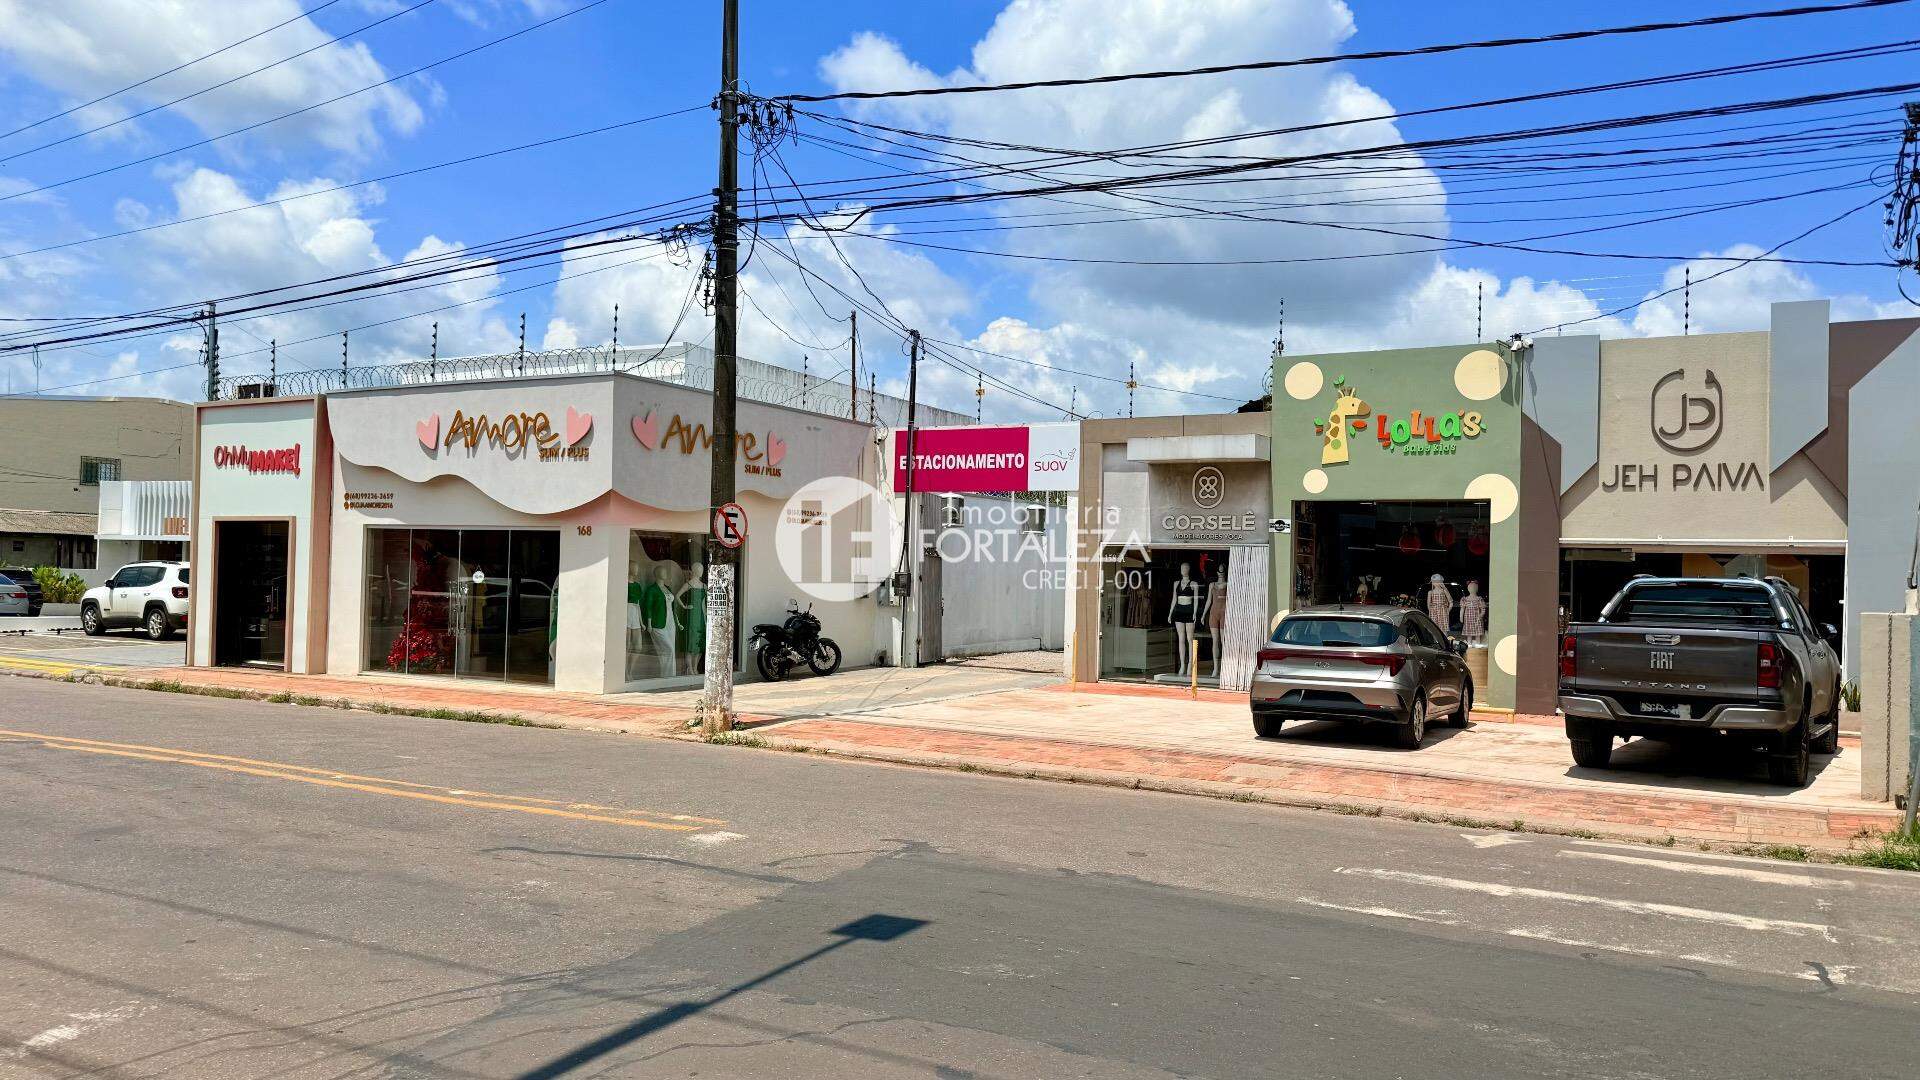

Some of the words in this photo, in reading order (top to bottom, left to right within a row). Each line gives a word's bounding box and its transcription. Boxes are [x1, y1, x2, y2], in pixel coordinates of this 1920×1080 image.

[444, 409, 560, 448] Amore
[899, 453, 1025, 470] ESTACIONAMENTO
[766, 467, 782, 477] PLUS
[1602, 464, 1658, 492] JEH
[1672, 463, 1765, 492] PAIVA
[724, 512, 739, 540] E
[1161, 510, 1256, 531] CORSELÊ
[576, 525, 592, 536] 168
[1650, 651, 1675, 670] FIAT
[1621, 680, 1706, 690] TITANO
